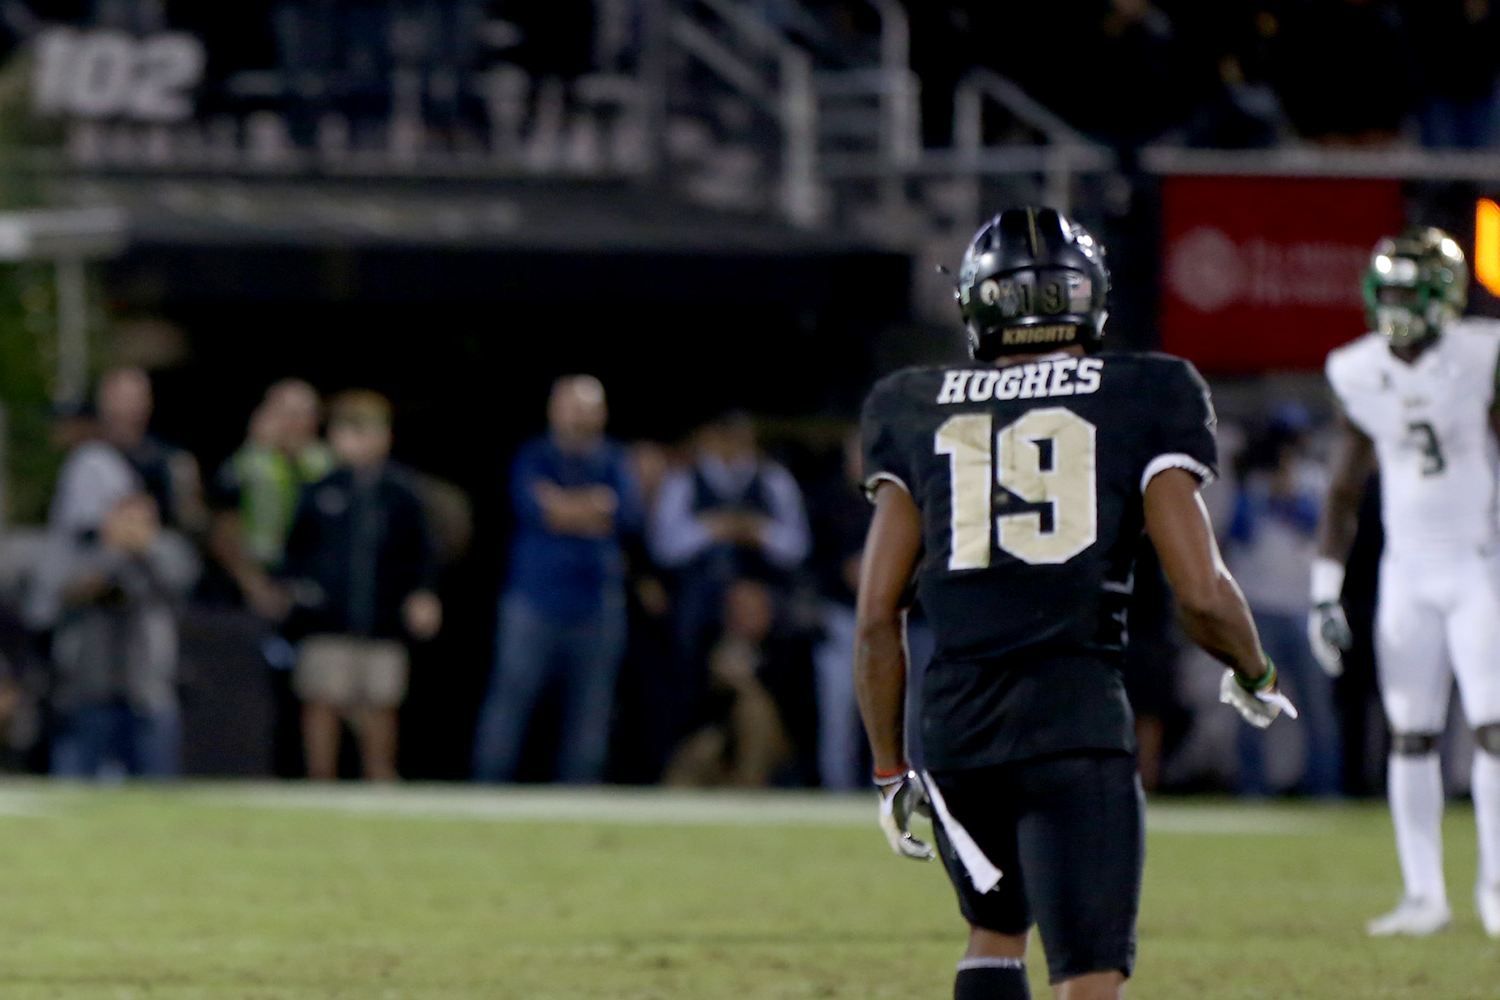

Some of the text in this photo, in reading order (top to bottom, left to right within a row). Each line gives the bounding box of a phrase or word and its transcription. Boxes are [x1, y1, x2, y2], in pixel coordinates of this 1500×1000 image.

[36, 28, 205, 120] 102
[1002, 324, 1077, 345] KNIGHTS
[936, 357, 1104, 404] HUGHES
[934, 406, 1097, 571] 19
